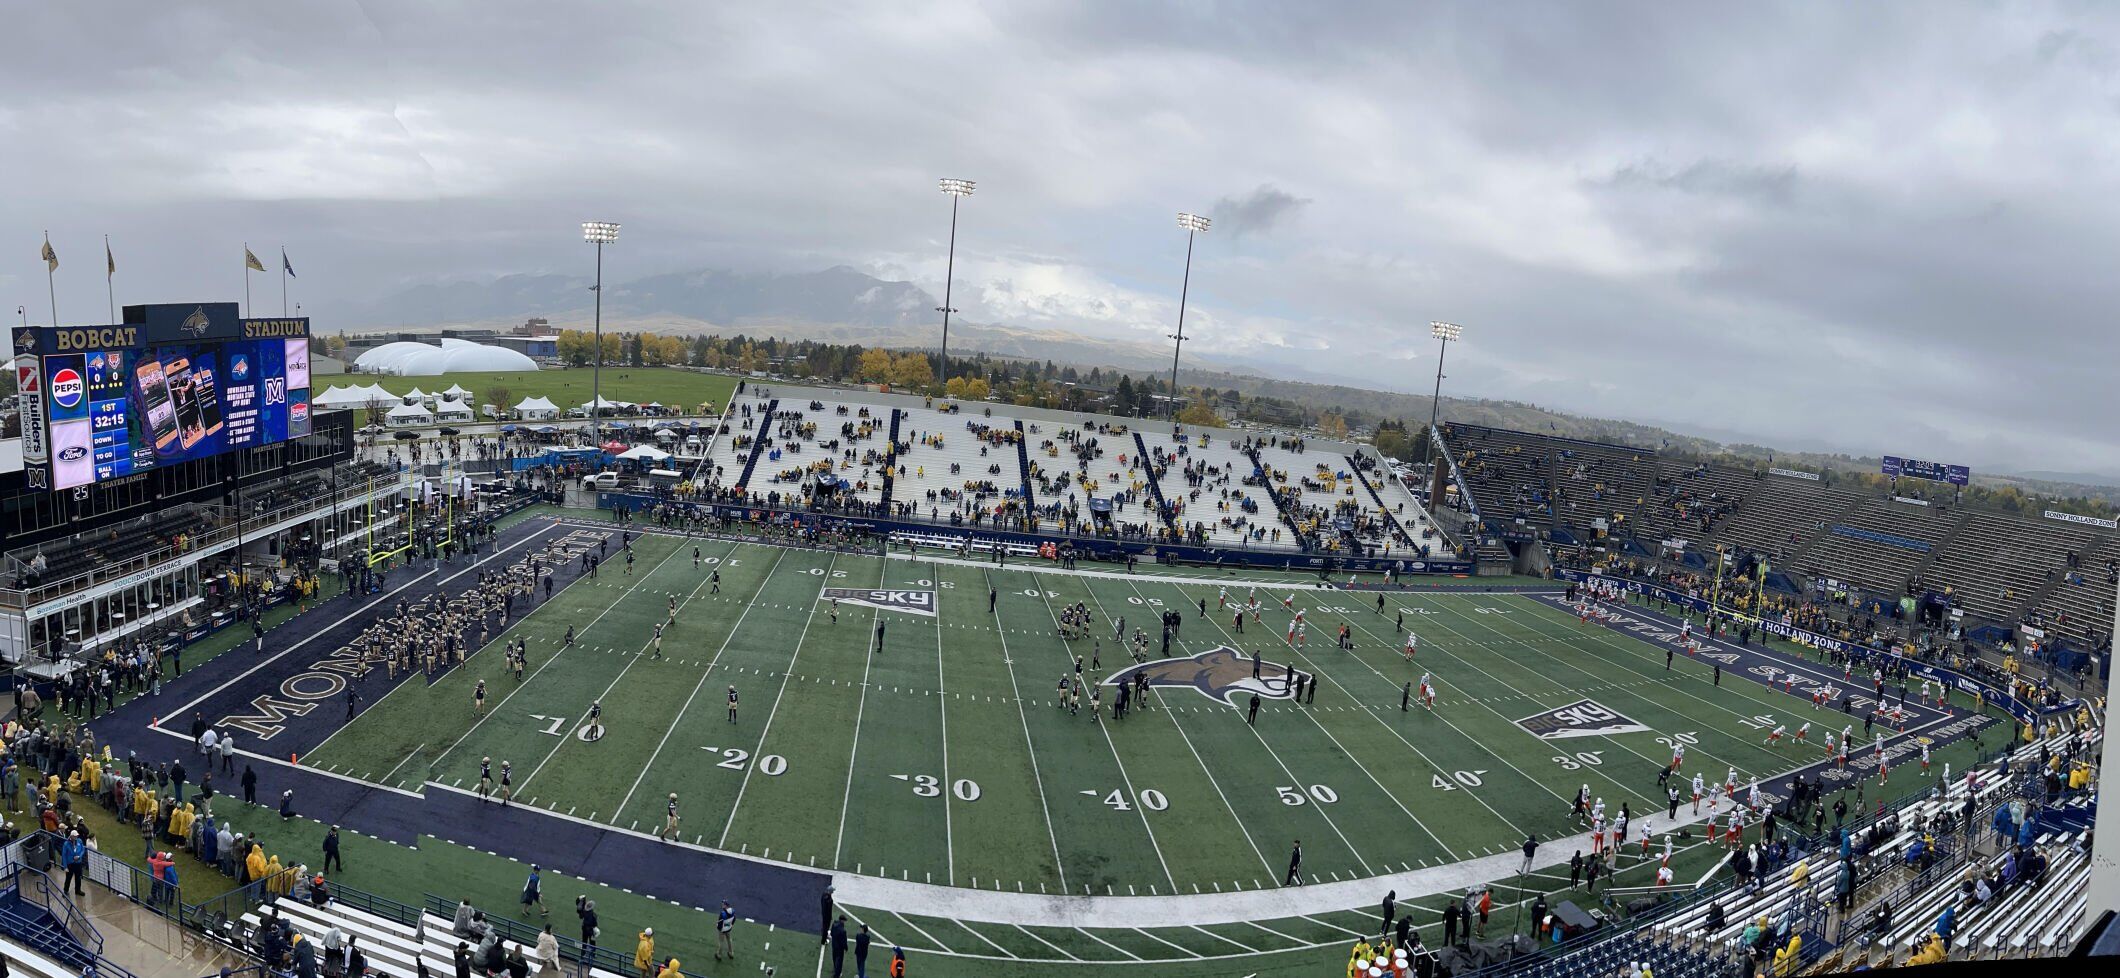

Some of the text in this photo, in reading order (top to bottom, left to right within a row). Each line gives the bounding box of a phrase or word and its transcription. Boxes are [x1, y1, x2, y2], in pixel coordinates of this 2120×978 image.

[245, 320, 305, 338] STADIUM
[56, 327, 137, 350] BOBCAT
[94, 373, 100, 382] 0
[112, 371, 118, 380] 0
[54, 383, 81, 393] PEPSI
[101, 403, 116, 412] 1ST
[29, 394, 42, 453] Builders
[95, 413, 124, 427] 32:15
[94, 436, 112, 444] DOWN
[63, 448, 83, 460] Ford
[100, 472, 148, 489] THAYER FAMILY
[2046, 511, 2116, 528] SONNY HOLLAND ZONE
[222, 541, 236, 551] Health
[114, 559, 182, 588] TOUCHDOWN TERRACE
[36, 593, 87, 615] Bozeman Health
[1765, 620, 1812, 645] HOLLAND
[1812, 636, 1842, 652] ZONE
[537, 716, 607, 743] 10
[716, 748, 789, 776] 20
[1551, 753, 1604, 771] 30
[912, 774, 982, 801] 30
[1431, 769, 1484, 792] 40
[1103, 788, 1170, 812] 40
[1275, 783, 1340, 806] 50
